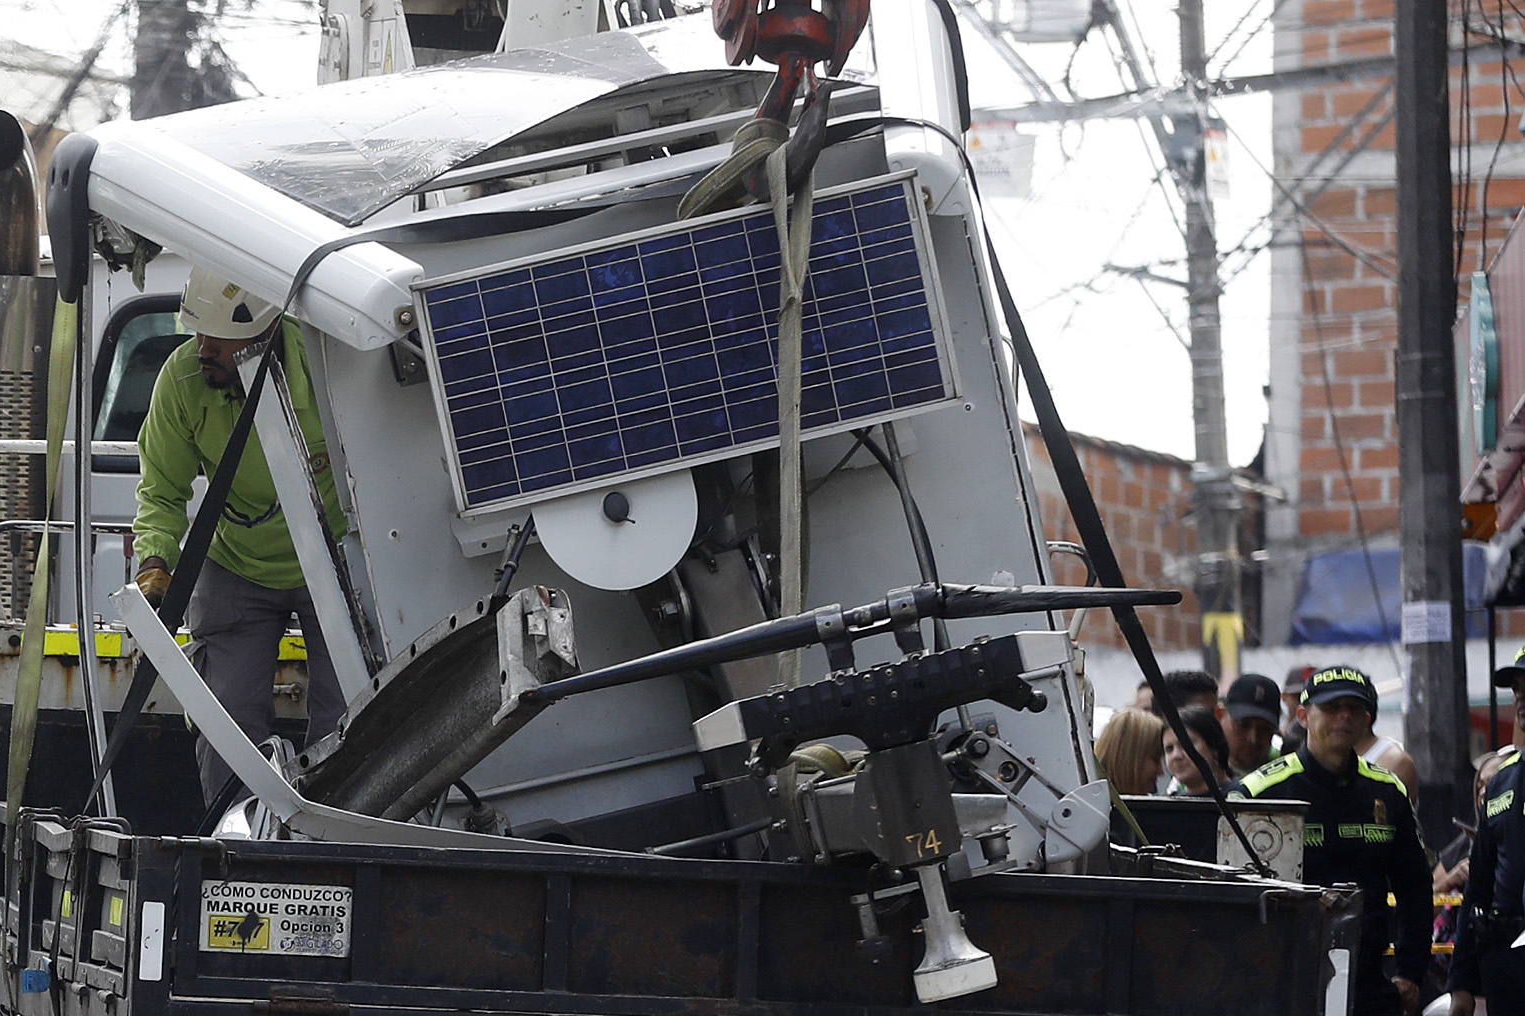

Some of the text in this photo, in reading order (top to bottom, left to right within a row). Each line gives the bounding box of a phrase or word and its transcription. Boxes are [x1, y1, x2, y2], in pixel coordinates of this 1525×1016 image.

[905, 829, 943, 858] 74
[259, 887, 353, 903] CONDUZCO?
[206, 901, 346, 918] MARQUE GRATIS
[213, 919, 265, 938] #77
[336, 922, 344, 934] 3
